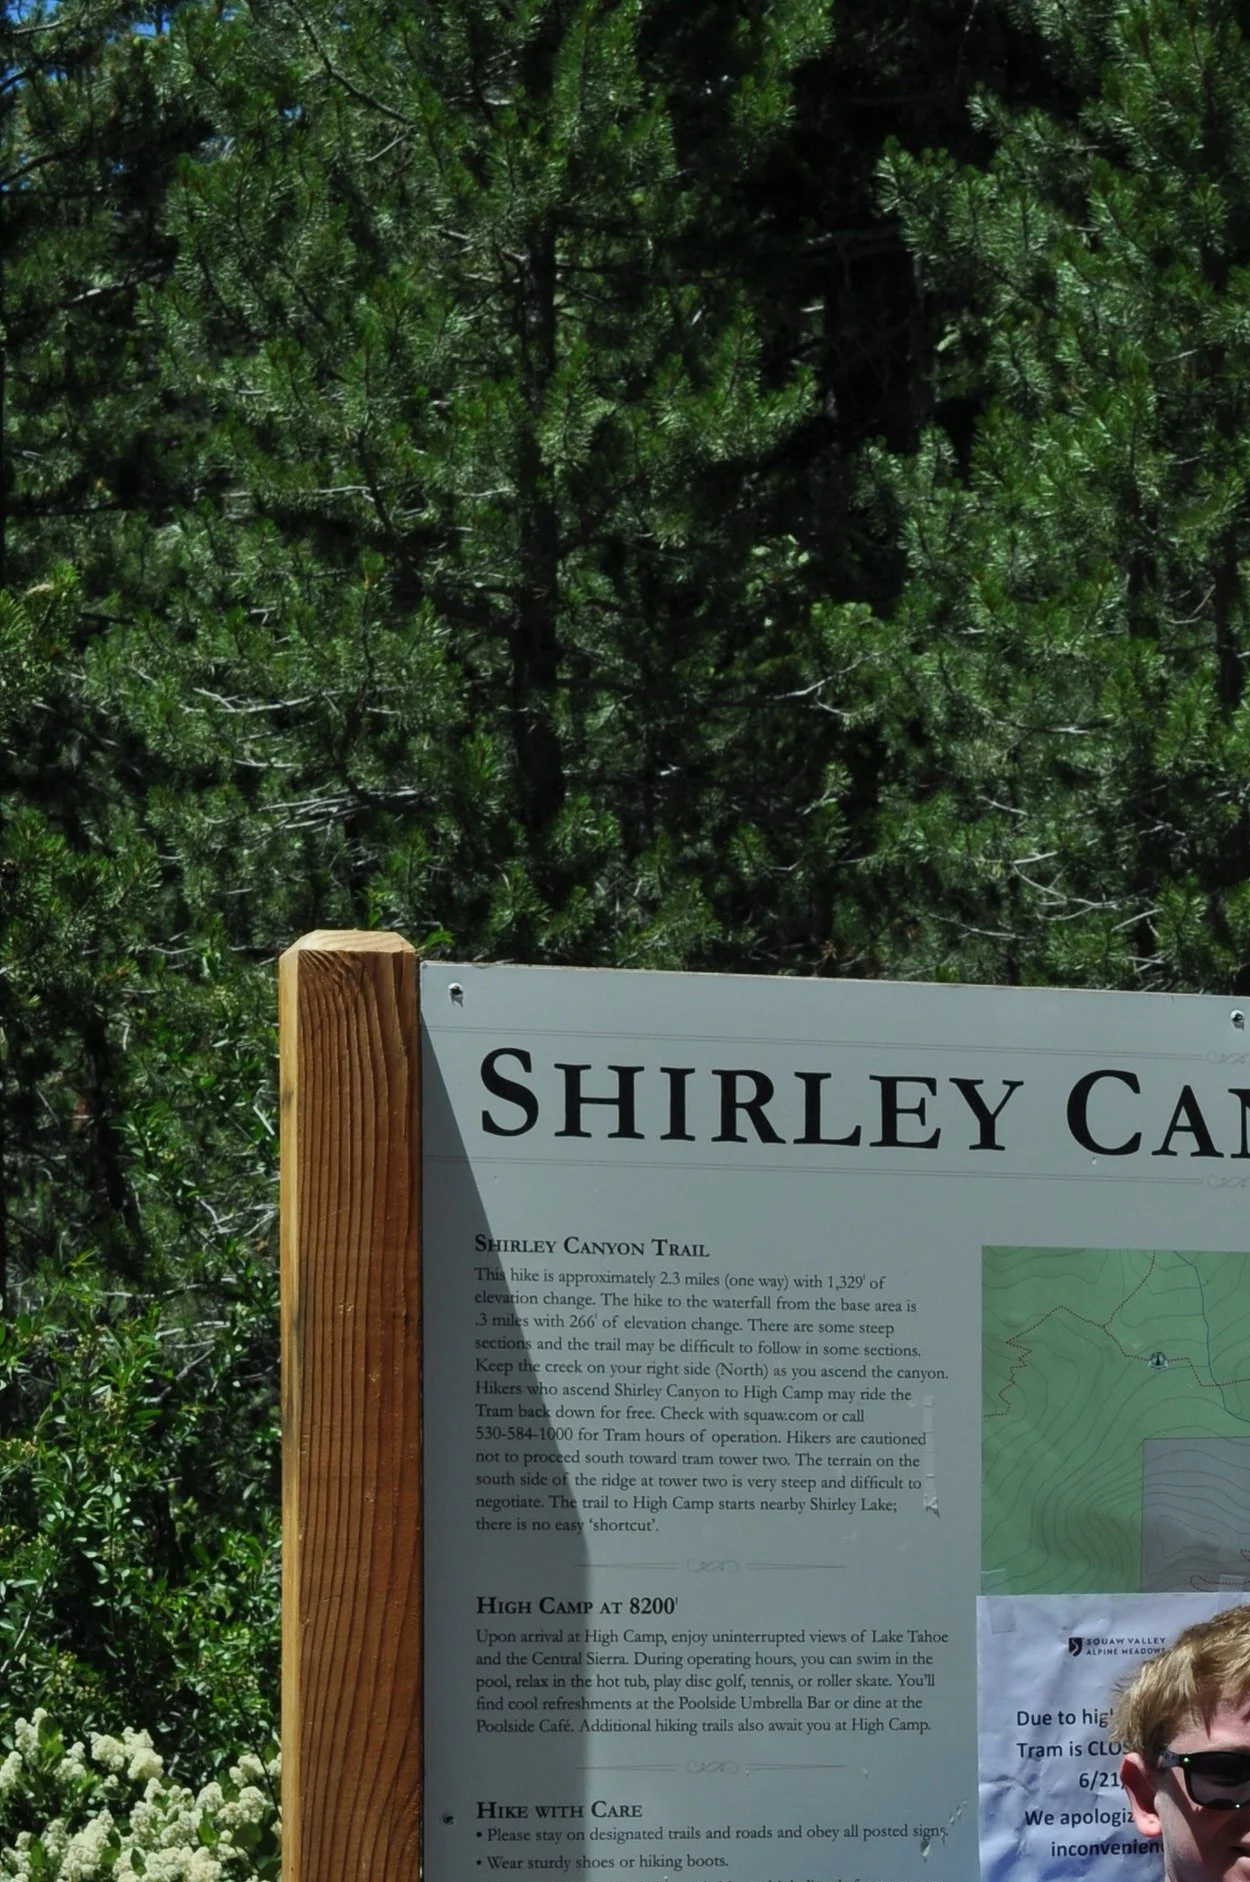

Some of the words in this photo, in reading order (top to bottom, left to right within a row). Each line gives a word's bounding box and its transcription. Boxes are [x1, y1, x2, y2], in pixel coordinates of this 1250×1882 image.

[481, 1048, 1024, 1151] SHIRLEY
[474, 1233, 558, 1253] SHIRLEY
[559, 1235, 645, 1255] CANYON
[650, 1236, 710, 1257] TRAIL
[474, 1266, 505, 1281] This
[510, 1267, 539, 1282] hike
[543, 1268, 554, 1282] is
[558, 1268, 656, 1288] approximately
[659, 1270, 680, 1285] 2.3
[684, 1271, 722, 1286] miles
[721, 1272, 754, 1290] (one
[757, 1273, 788, 1291] way)
[792, 1273, 822, 1288] with
[827, 1272, 865, 1291] 1,329'
[869, 1275, 886, 1290] of
[475, 1379, 524, 1396] Hikers
[523, 1381, 558, 1396] who
[559, 1381, 612, 1396] ascend
[611, 1378, 662, 1401] Shirley
[665, 1383, 719, 1402] Canyon
[724, 1387, 741, 1398] to
[743, 1384, 777, 1403] High
[781, 1383, 823, 1404] Camp
[827, 1389, 856, 1404] may
[859, 1386, 886, 1400] ride
[890, 1387, 911, 1401] the
[474, 1423, 573, 1441] 530-584-1000
[577, 1426, 599, 1441] for
[602, 1425, 640, 1442] Tram
[644, 1427, 685, 1442] hours
[689, 1428, 707, 1442] of
[710, 1424, 781, 1448] operation.
[785, 1429, 831, 1444] Hikers
[835, 1434, 856, 1444] are
[860, 1431, 928, 1445] cautioned
[475, 1595, 533, 1614] HIGH
[535, 1595, 593, 1615] CAMP
[598, 1601, 623, 1614] AT
[628, 1594, 678, 1615] 8200'
[475, 1628, 516, 1647] Upon
[519, 1628, 564, 1643] arrival
[566, 1632, 581, 1642] at
[584, 1628, 619, 1647] High
[622, 1628, 668, 1647] Camp,
[671, 1628, 709, 1647] enjoy
[711, 1628, 805, 1648] uninterrupted
[808, 1629, 849, 1643] views
[848, 1628, 868, 1643] of
[871, 1628, 905, 1643] Lake
[906, 1629, 948, 1643] Tahoe
[1086, 1637, 1125, 1646] SQUAW
[1127, 1637, 1166, 1645] VALLEY
[1086, 1647, 1118, 1656] ALPINE
[475, 1718, 535, 1733] Poolside
[538, 1715, 574, 1734] Café.
[578, 1715, 652, 1732] Additional
[654, 1717, 700, 1736] hiking
[701, 1717, 733, 1732] trails
[737, 1717, 764, 1731] also
[767, 1717, 803, 1731] await
[804, 1721, 833, 1736] you
[834, 1720, 847, 1731] at
[851, 1716, 884, 1735] High
[888, 1712, 931, 1735] Camp.
[1016, 1711, 1052, 1727] Due
[1058, 1710, 1077, 1725] to
[1082, 1708, 1114, 1728] hig
[1016, 1742, 1063, 1759] Tram
[1069, 1741, 1083, 1757] is
[1079, 1771, 1125, 1791] 6/21
[475, 1800, 529, 1820] HIKE
[531, 1805, 584, 1818] WITH
[590, 1799, 643, 1818] CARE
[1025, 1810, 1055, 1826] We
[1060, 1808, 1135, 1828] apologiz
[1051, 1839, 1165, 1858] inconvenien
